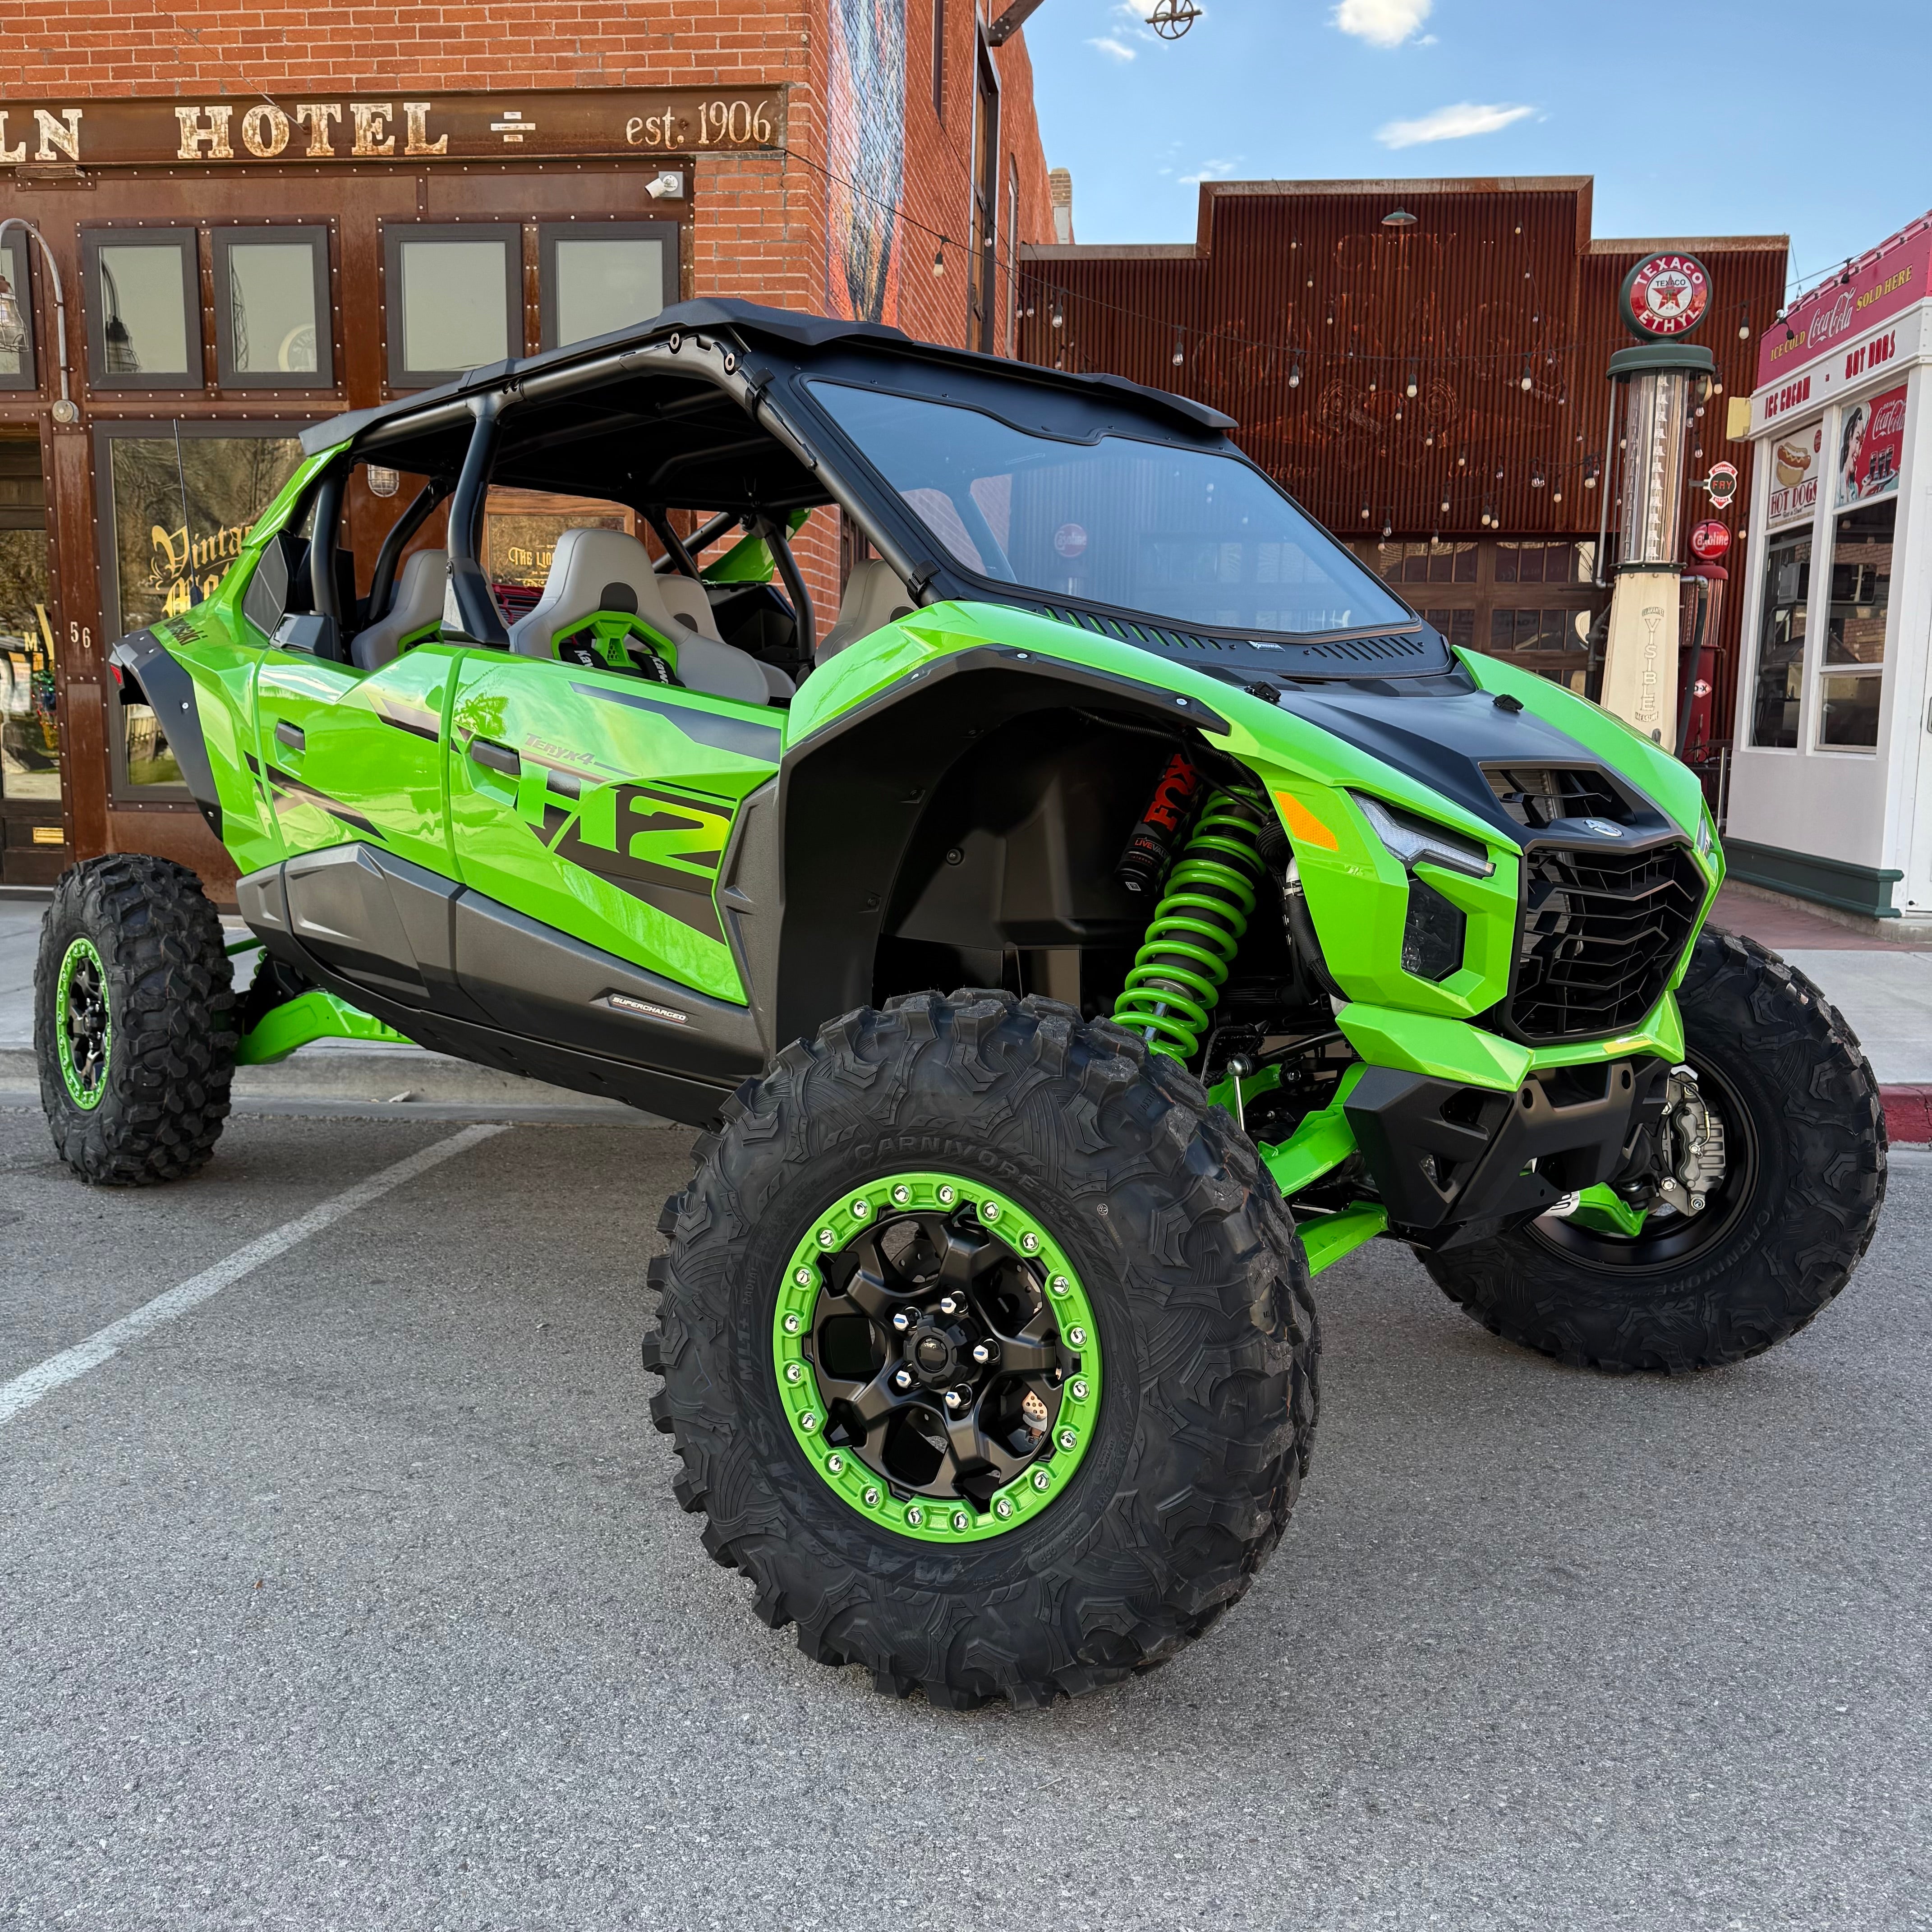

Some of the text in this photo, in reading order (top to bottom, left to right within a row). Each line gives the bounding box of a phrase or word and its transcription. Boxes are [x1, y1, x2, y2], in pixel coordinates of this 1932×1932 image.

[175, 102, 448, 160] HOTEL
[626, 106, 685, 150] est.
[698, 100, 772, 145] 1906
[1633, 257, 1703, 285] TEXACO
[1656, 279, 1686, 287] TEXACO
[1638, 309, 1700, 332] ETHYL
[1770, 343, 1784, 363] ICE
[1784, 330, 1806, 355] COLD
[1856, 284, 1882, 313] SOLD
[1883, 263, 1914, 296] HERE
[1764, 329, 1896, 420] ICE CREAM HOT DOGS
[1771, 490, 1790, 515] HOT
[149, 523, 254, 580] Vinta
[508, 547, 533, 566] THE
[1642, 606, 1664, 617] GUARANTEE
[70, 621, 91, 649] 56
[1640, 618, 1661, 711] VISIBLE
[1143, 753, 1198, 832] FOX
[516, 761, 731, 880] H2
[612, 997, 686, 1021] SUPERCHARGED
[854, 1136, 1039, 1193] CARNIVORE
